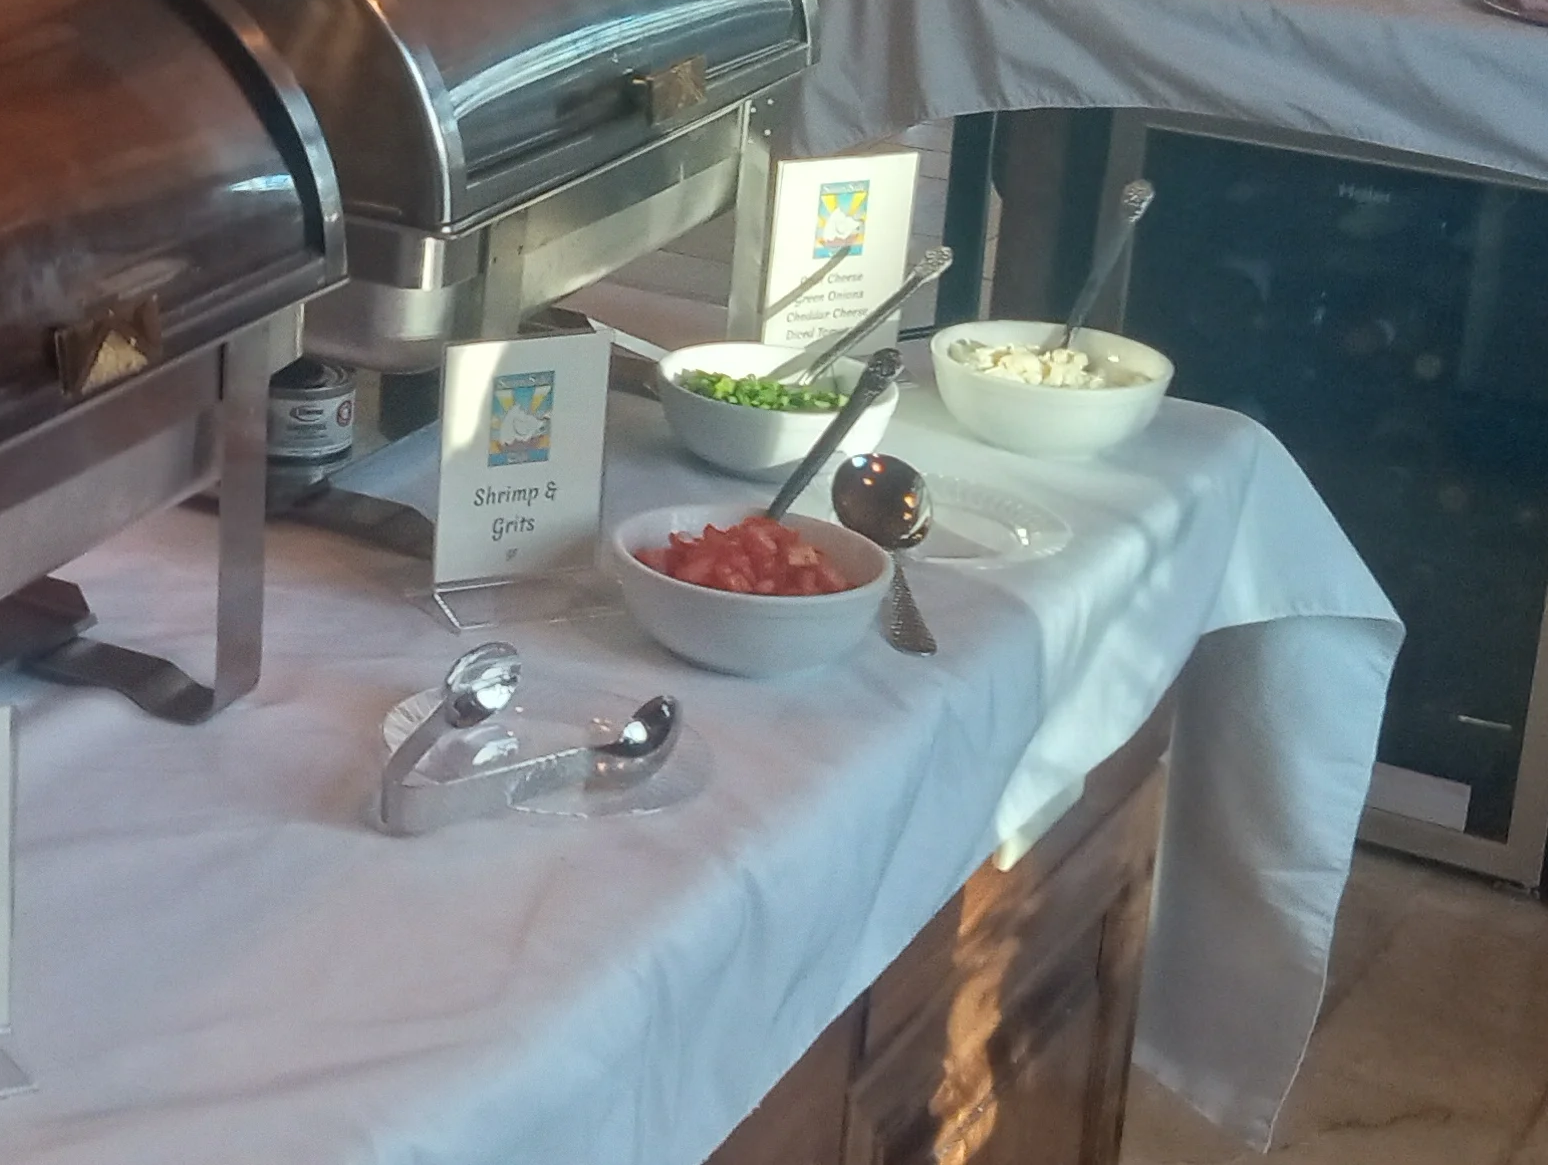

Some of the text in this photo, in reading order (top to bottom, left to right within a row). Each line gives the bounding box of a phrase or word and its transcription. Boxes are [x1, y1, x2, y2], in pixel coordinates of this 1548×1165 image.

[827, 273, 863, 284] Cheese
[827, 290, 864, 302] Onions
[786, 310, 831, 323] Cheddar
[785, 327, 816, 341] Diced
[473, 481, 558, 507] Shrimp &
[492, 515, 536, 542] Grits
